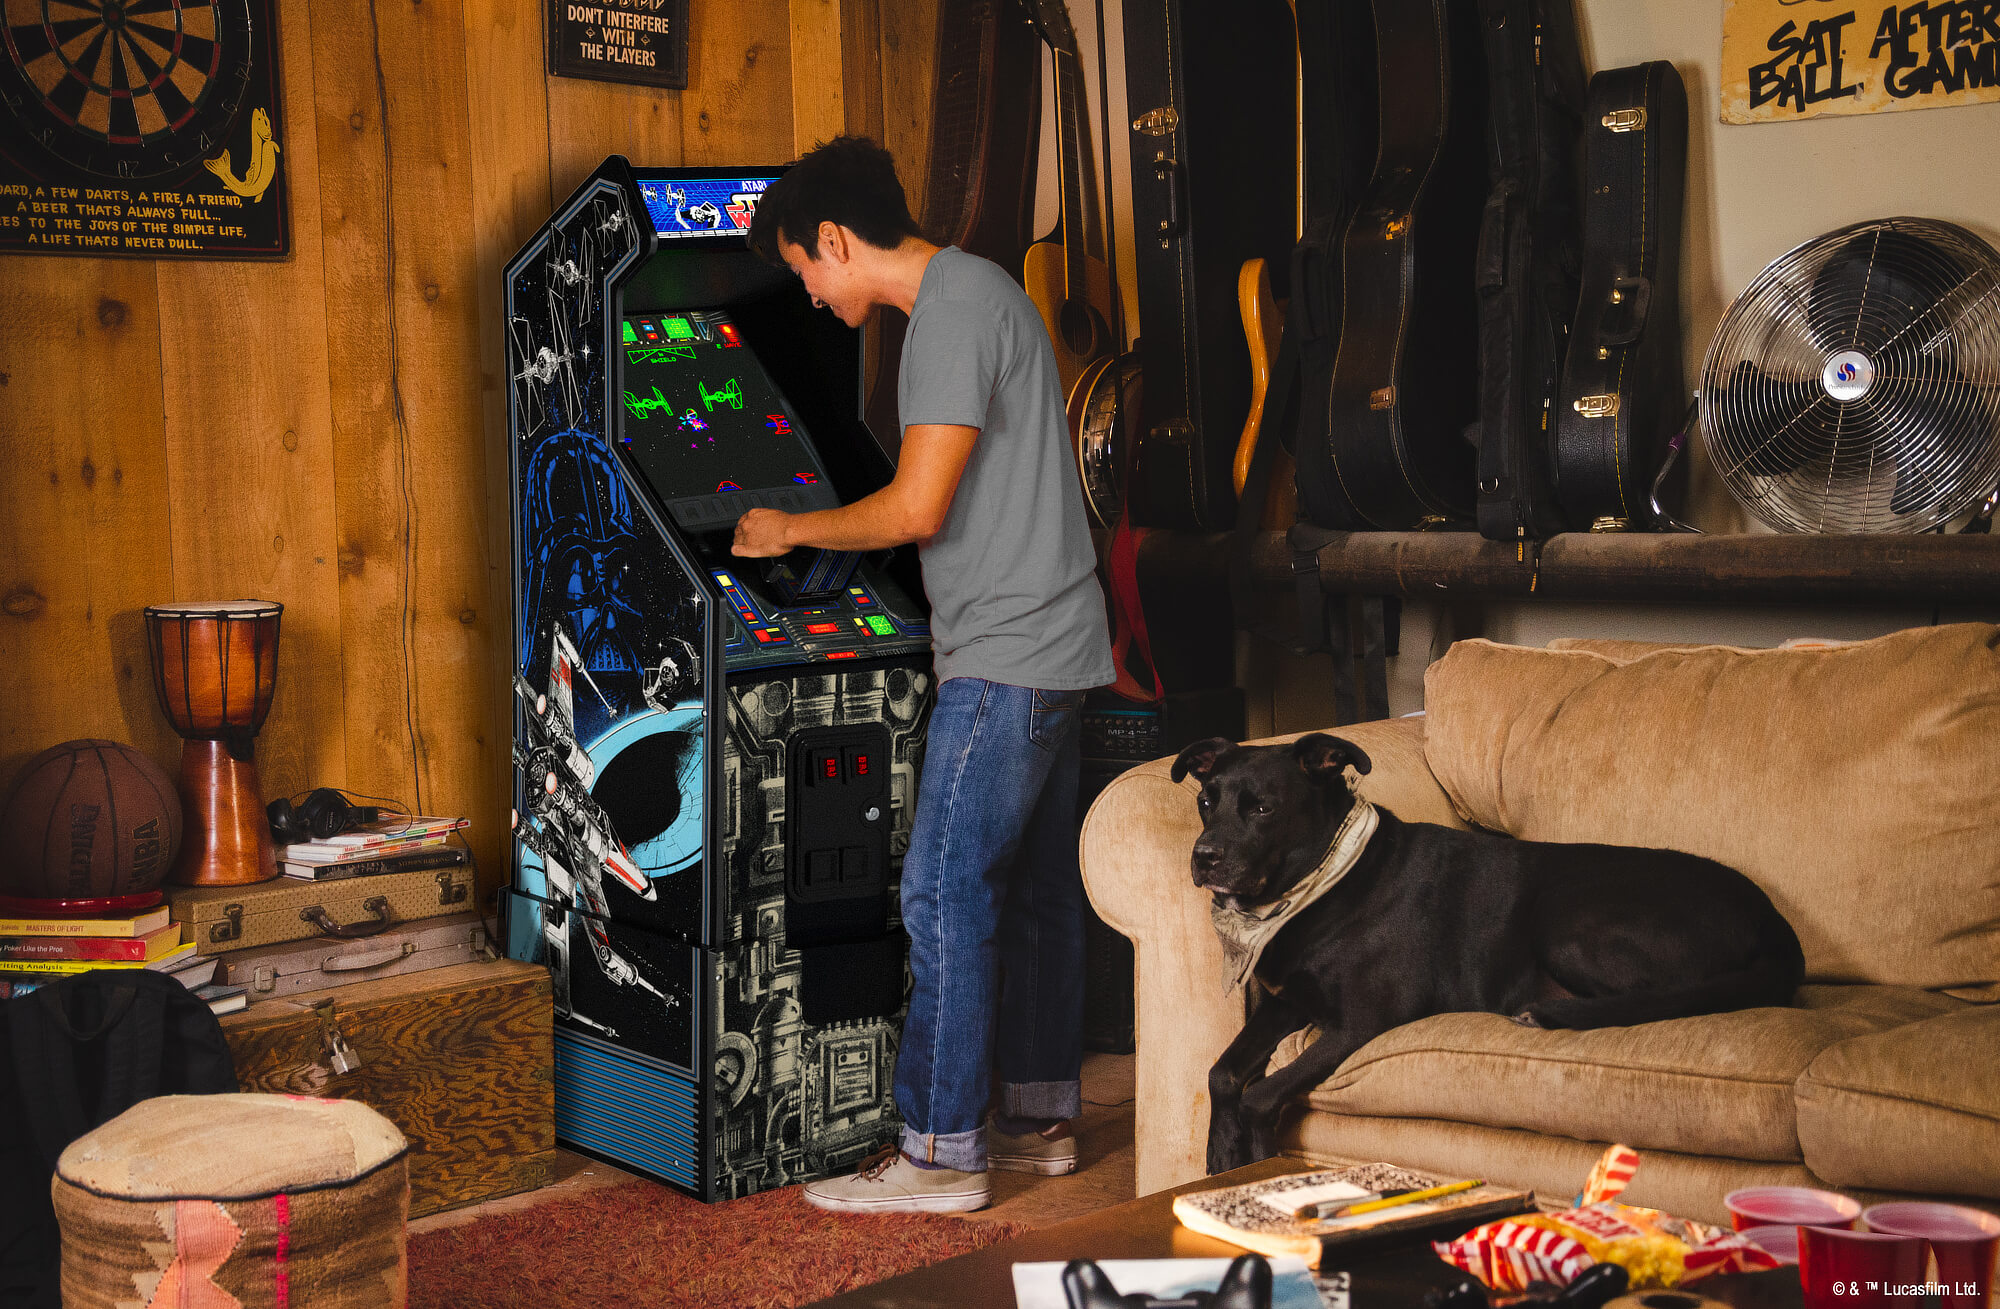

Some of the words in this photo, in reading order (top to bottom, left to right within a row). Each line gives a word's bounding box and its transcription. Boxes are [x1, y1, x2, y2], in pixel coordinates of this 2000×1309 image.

[567, 4, 604, 25] DON'T
[606, 10, 669, 34] INTERFERE
[601, 27, 635, 47] WITH
[1766, 10, 1856, 67] SAT.
[1868, 0, 2000, 68] AFTER
[580, 42, 603, 60] THE
[606, 45, 656, 67] PLAYERS
[1884, 41, 2000, 99] GAM
[741, 180, 767, 192] ATARI
[35, 186, 45, 197] A
[51, 187, 79, 199] FEW
[85, 189, 133, 204] DARTS,
[138, 191, 149, 202] A
[152, 192, 183, 207] FIRE,
[186, 193, 195, 204] A
[198, 194, 243, 208] FRIEND,
[17, 201, 27, 213] A
[32, 202, 68, 214] BEER
[75, 204, 121, 217] THATS
[127, 206, 175, 219] ALWAYS
[180, 208, 221, 221] FULL...
[0, 216, 20, 228] ES
[28, 217, 46, 229] TO
[54, 218, 82, 230] THE
[89, 219, 119, 231] JOYS
[122, 221, 138, 233] OF
[142, 222, 168, 234] THE
[173, 223, 215, 235] SIMPLE
[219, 225, 247, 239] LIFE,
[28, 233, 38, 243] A
[42, 233, 71, 245] LIFE
[75, 235, 119, 247] THATS
[125, 237, 165, 248] NEVER
[167, 238, 204, 250] DULL.
[4, 944, 22, 952] Poker
[48, 945, 63, 953] Pros
[27, 963, 63, 971] Analysis
